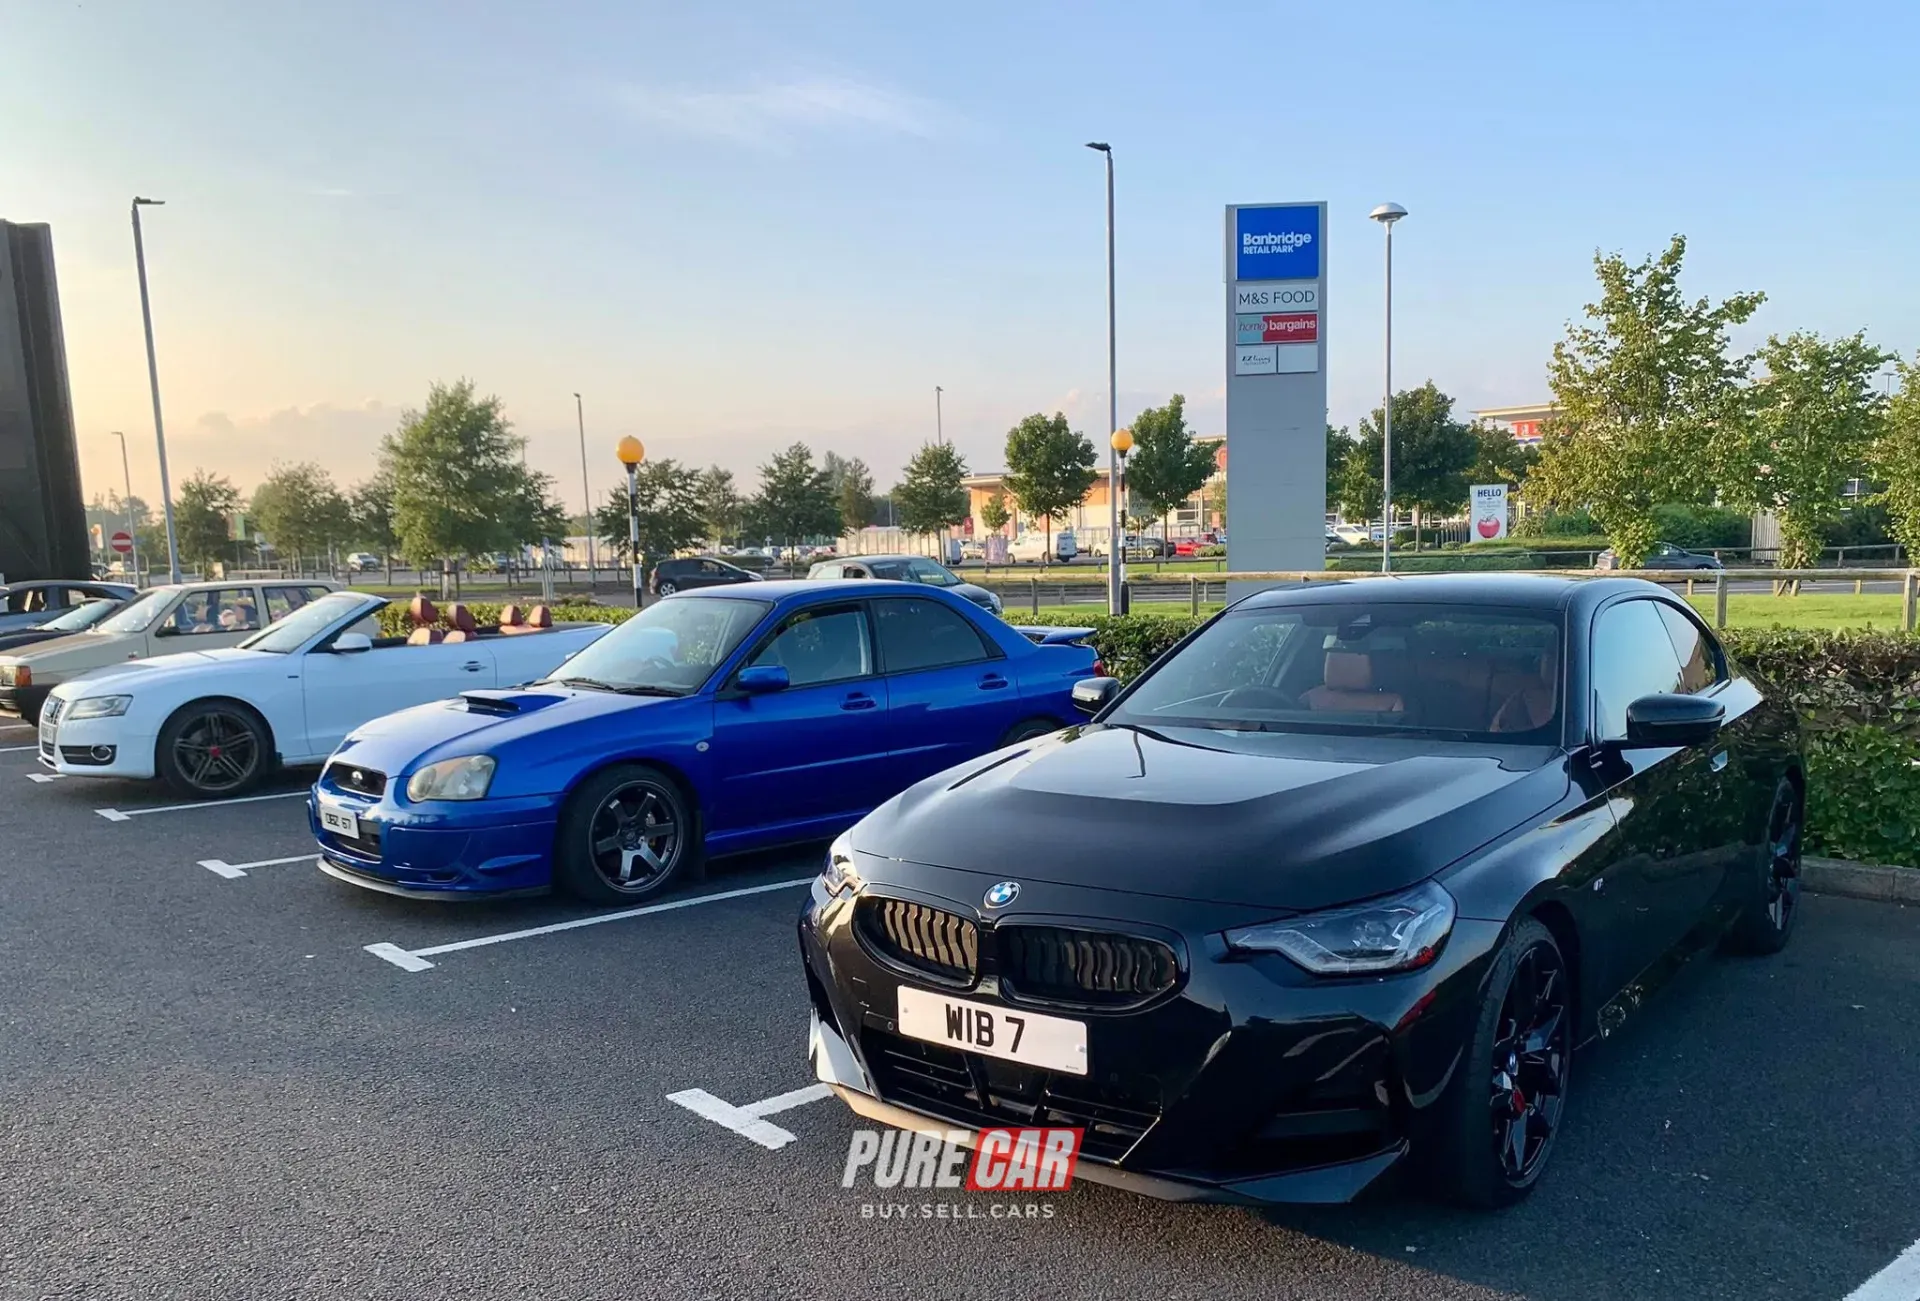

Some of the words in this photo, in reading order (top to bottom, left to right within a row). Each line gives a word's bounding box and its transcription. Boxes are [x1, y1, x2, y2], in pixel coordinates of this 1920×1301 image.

[1243, 232, 1312, 247] Banbridge
[1243, 246, 1270, 255] RETAIL
[1271, 245, 1294, 254] PARK
[1239, 292, 1269, 305] M&S
[1273, 290, 1315, 304] FOOD
[1269, 318, 1315, 332] bargains
[1477, 488, 1502, 498] HELLO
[945, 1003, 995, 1048] WIB
[1005, 1016, 1025, 1053] 7
